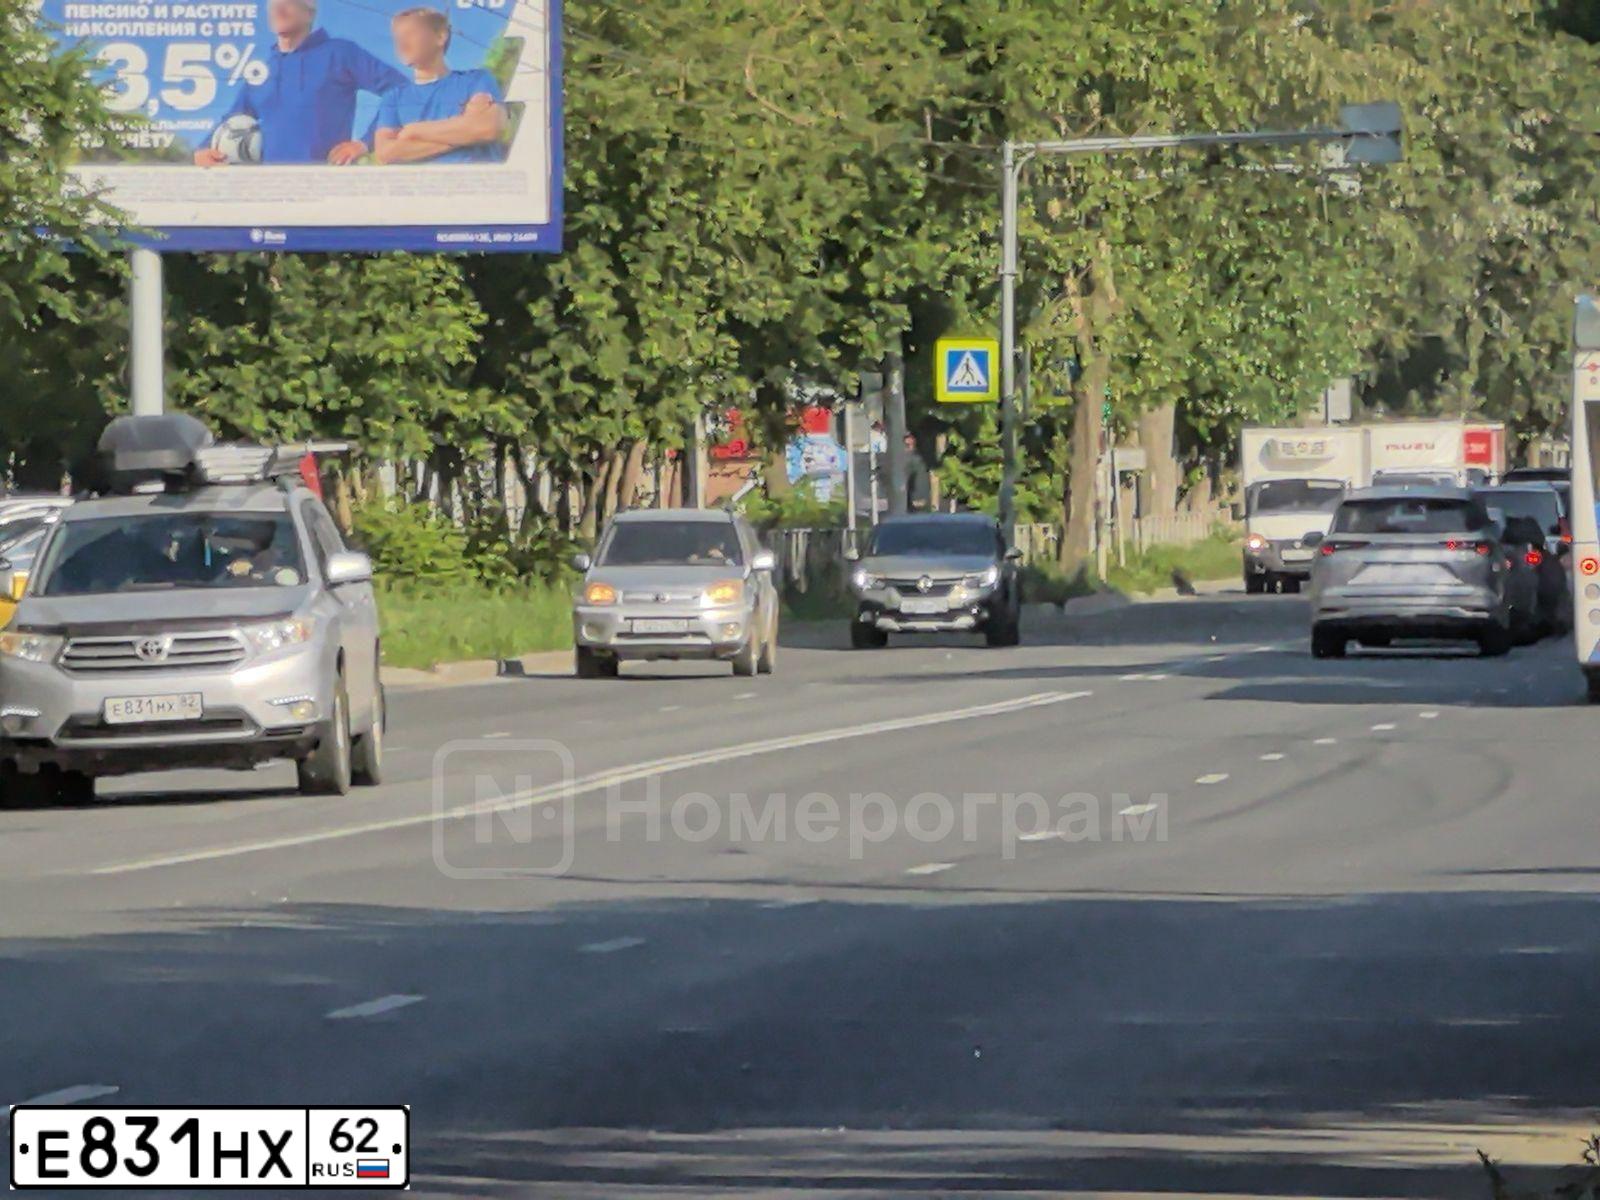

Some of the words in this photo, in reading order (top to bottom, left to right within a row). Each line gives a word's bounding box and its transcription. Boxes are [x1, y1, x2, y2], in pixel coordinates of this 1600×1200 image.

[65, 4, 149, 19] ПЕНСИЮ
[154, 4, 168, 19] И
[172, 4, 257, 19] РАСТИТЕ
[65, 22, 196, 37] НАКОПЛЕНИЯ
[201, 22, 213, 36] С
[218, 22, 255, 36] ВТБ
[97, 43, 269, 117] 3,5%
